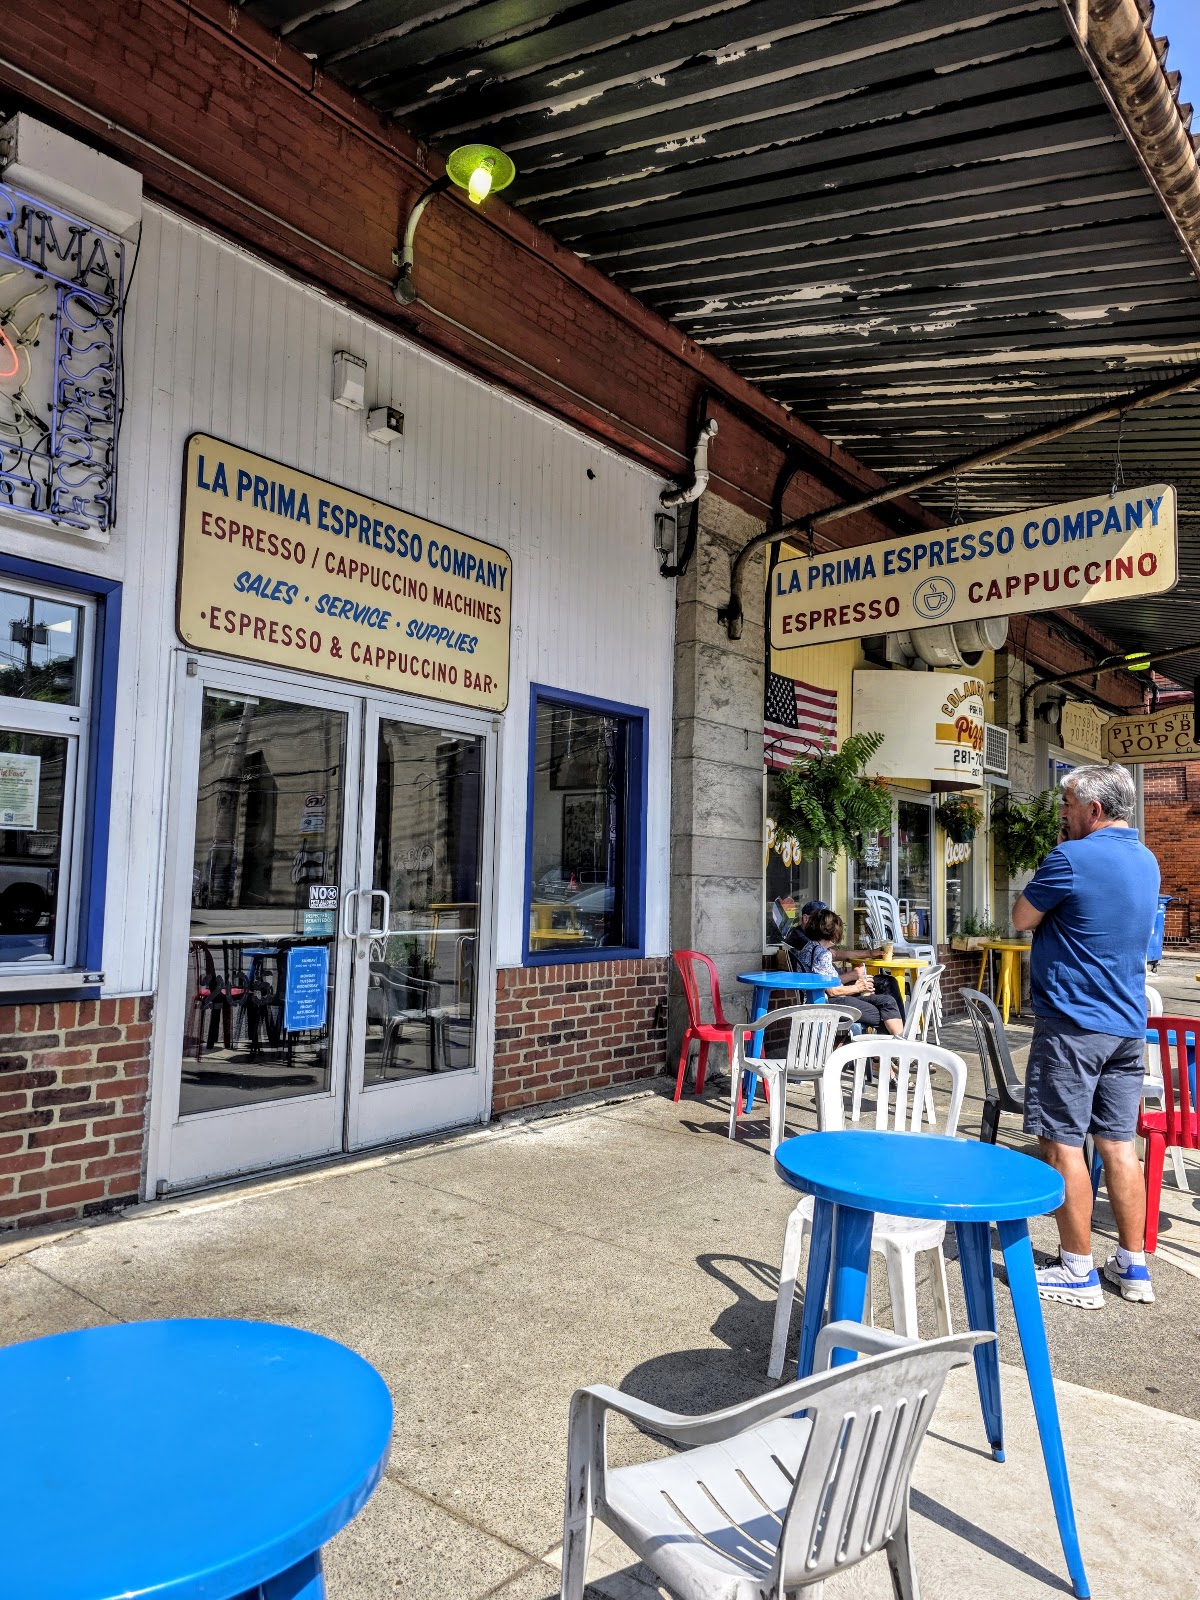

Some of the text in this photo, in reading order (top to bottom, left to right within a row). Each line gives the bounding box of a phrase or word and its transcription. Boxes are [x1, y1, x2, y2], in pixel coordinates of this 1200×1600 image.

[51, 291, 115, 532] ESPRESSO
[197, 455, 508, 592] LA PRIMA ESPRESSO COMPANY
[776, 496, 1164, 597] LA PRIMA ESPRESSO COMPANY
[202, 511, 306, 565] ESPRESSO
[325, 551, 428, 602] CAPPUCCINO
[433, 586, 501, 625] MACHINES
[782, 552, 1158, 635] ESPRESSO CAPPUCCINO
[208, 606, 493, 693] ESPRESSO & CAPPUCCINO BAR
[233, 571, 479, 654] SALES SERVICE SUPPLIES
[1112, 719, 1191, 739] PITTSB
[310, 886, 327, 900] NO
